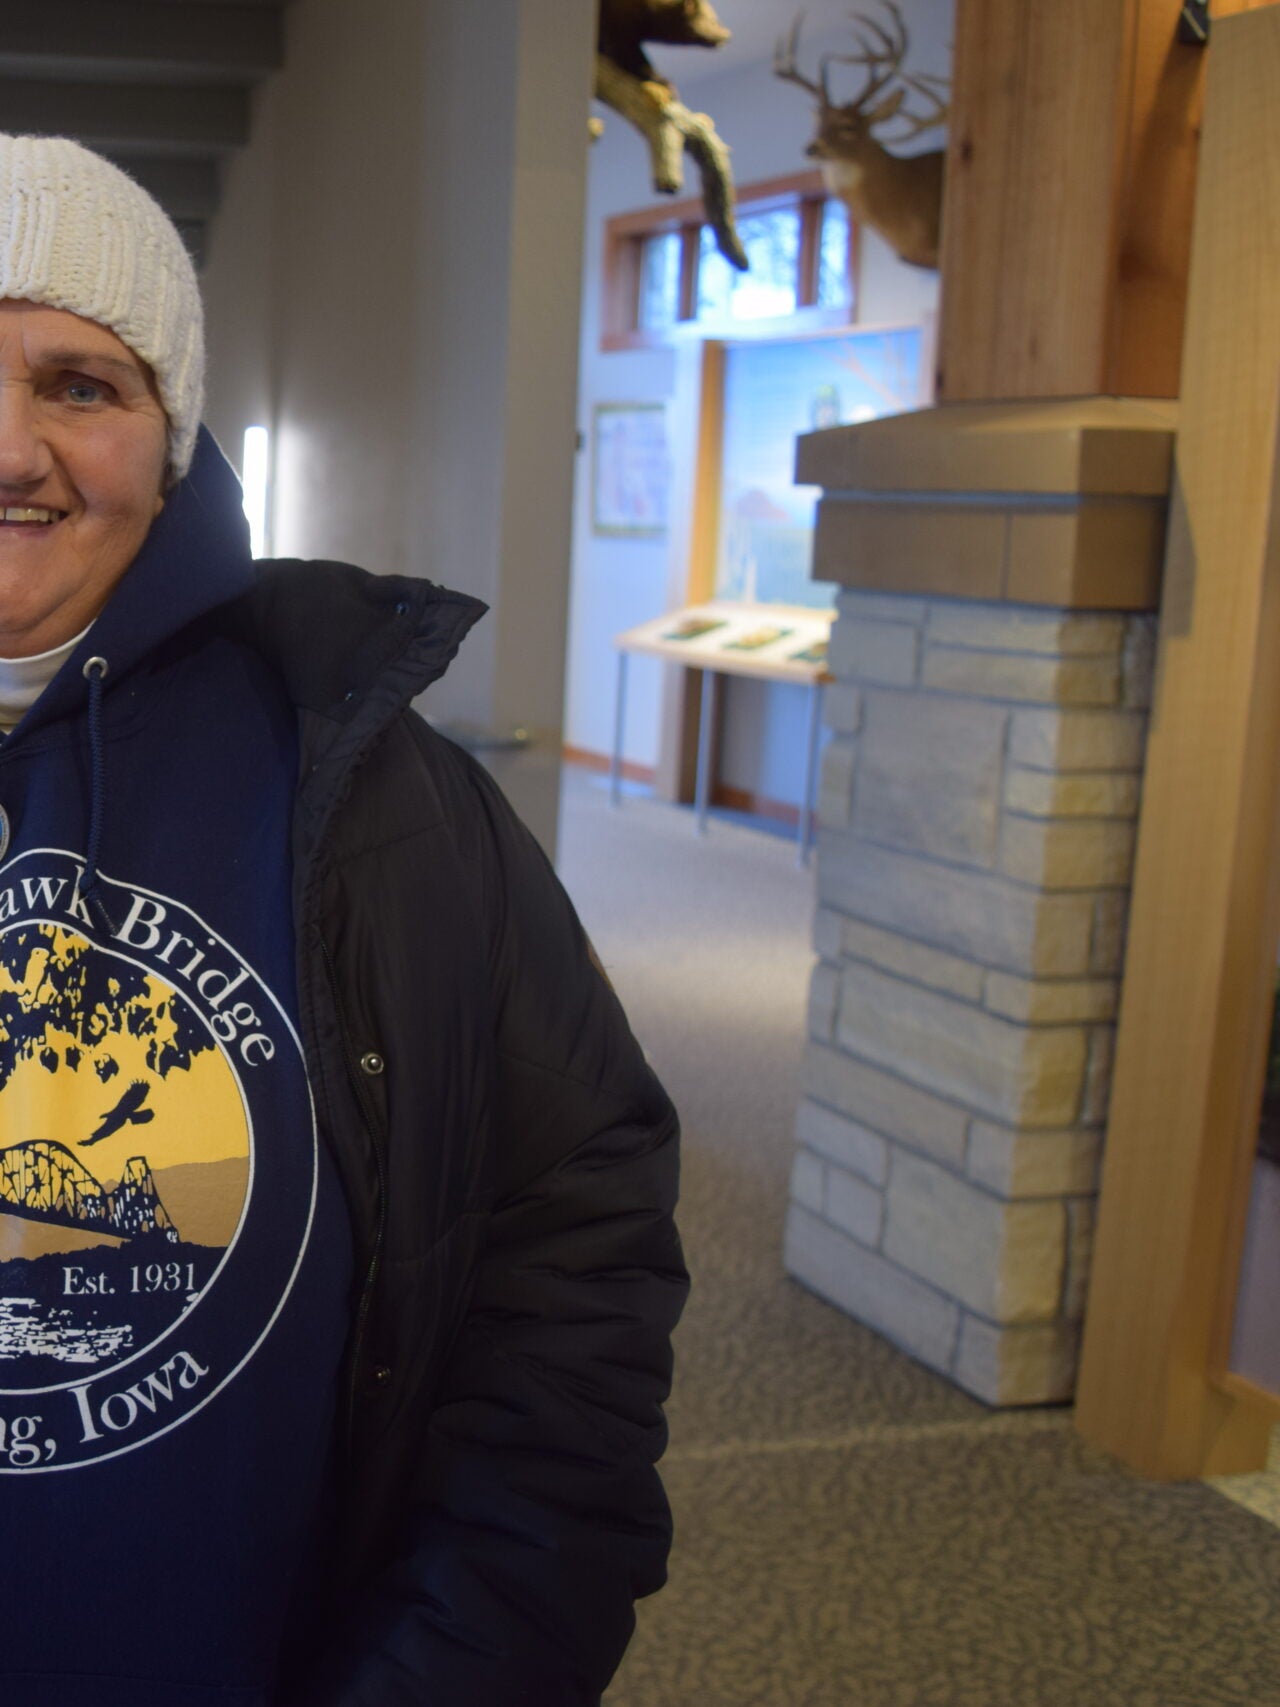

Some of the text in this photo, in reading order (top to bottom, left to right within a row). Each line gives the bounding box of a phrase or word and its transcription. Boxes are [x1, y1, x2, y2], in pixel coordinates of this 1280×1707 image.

[109, 893, 276, 1067] Bridge
[62, 1262, 195, 1295] Est. 1931
[68, 1350, 210, 1443] Iowa
